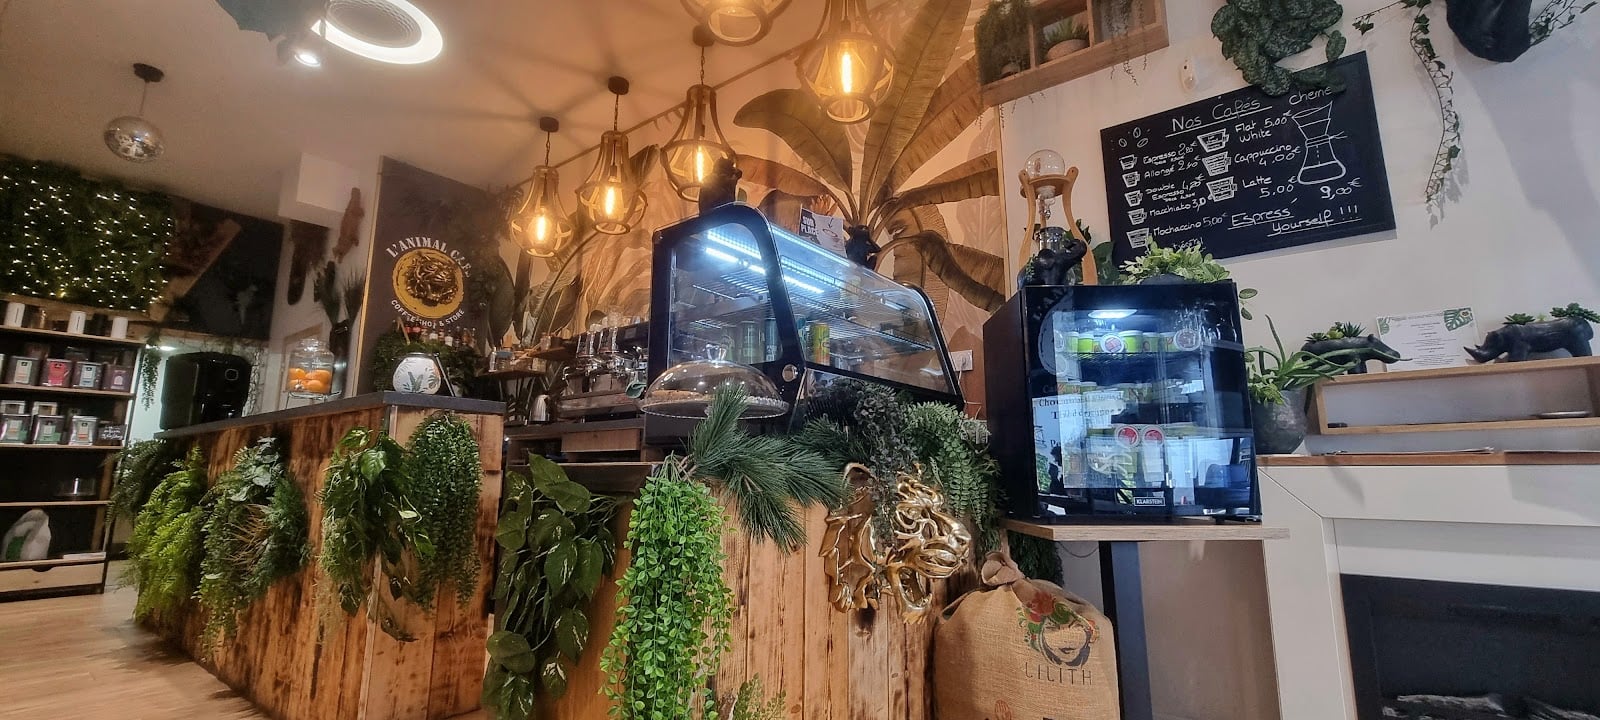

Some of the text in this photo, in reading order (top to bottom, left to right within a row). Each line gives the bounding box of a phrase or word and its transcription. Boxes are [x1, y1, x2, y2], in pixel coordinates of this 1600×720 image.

[1172, 116, 1202, 132] Nos
[1235, 120, 1257, 133] Flat
[1143, 151, 1177, 165] Espresso
[1234, 144, 1292, 164] Cappuccino
[1242, 175, 1273, 189] Latte
[1151, 190, 1185, 201] Espresso
[1149, 202, 1191, 217] Macchiato
[1153, 221, 1202, 236] Mochaccino
[386, 236, 447, 258] L'ANIMAL
[445, 308, 465, 325] STORE
